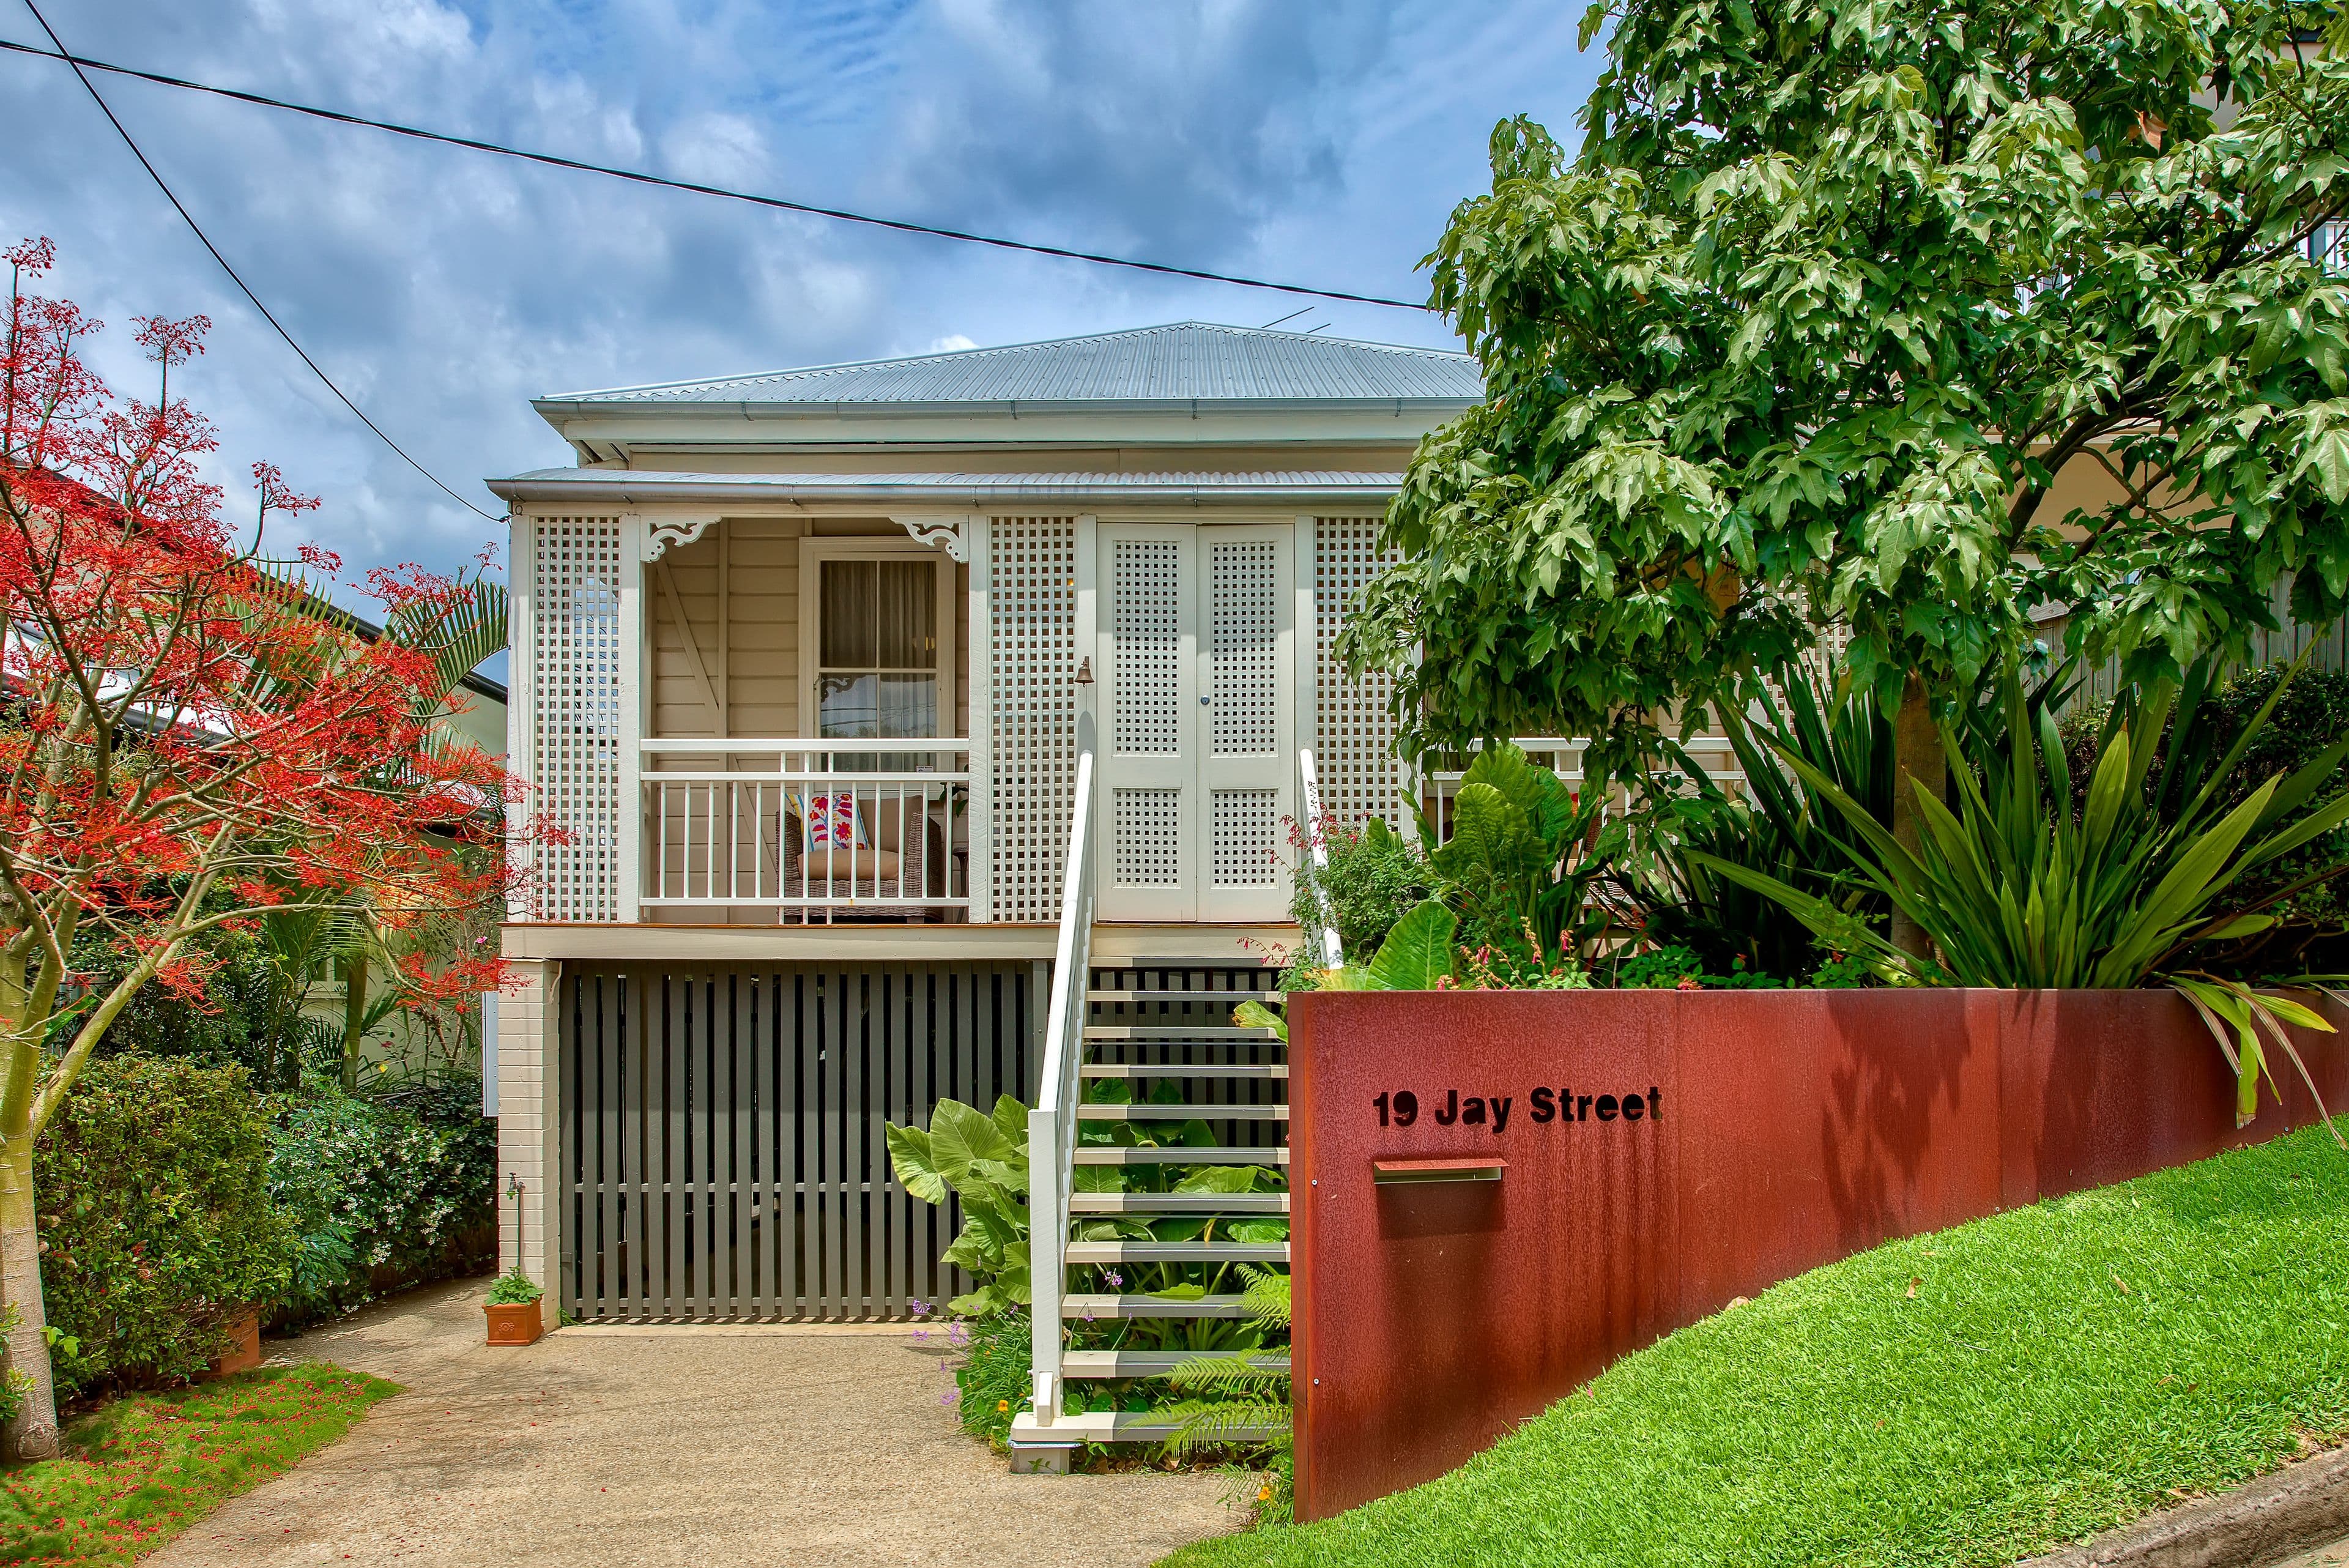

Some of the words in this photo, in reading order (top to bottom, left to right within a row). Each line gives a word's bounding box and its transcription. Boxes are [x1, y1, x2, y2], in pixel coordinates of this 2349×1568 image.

[1373, 1089, 1418, 1127] 19
[1434, 1090, 1513, 1134] Jay
[1530, 1086, 1663, 1123] Street
